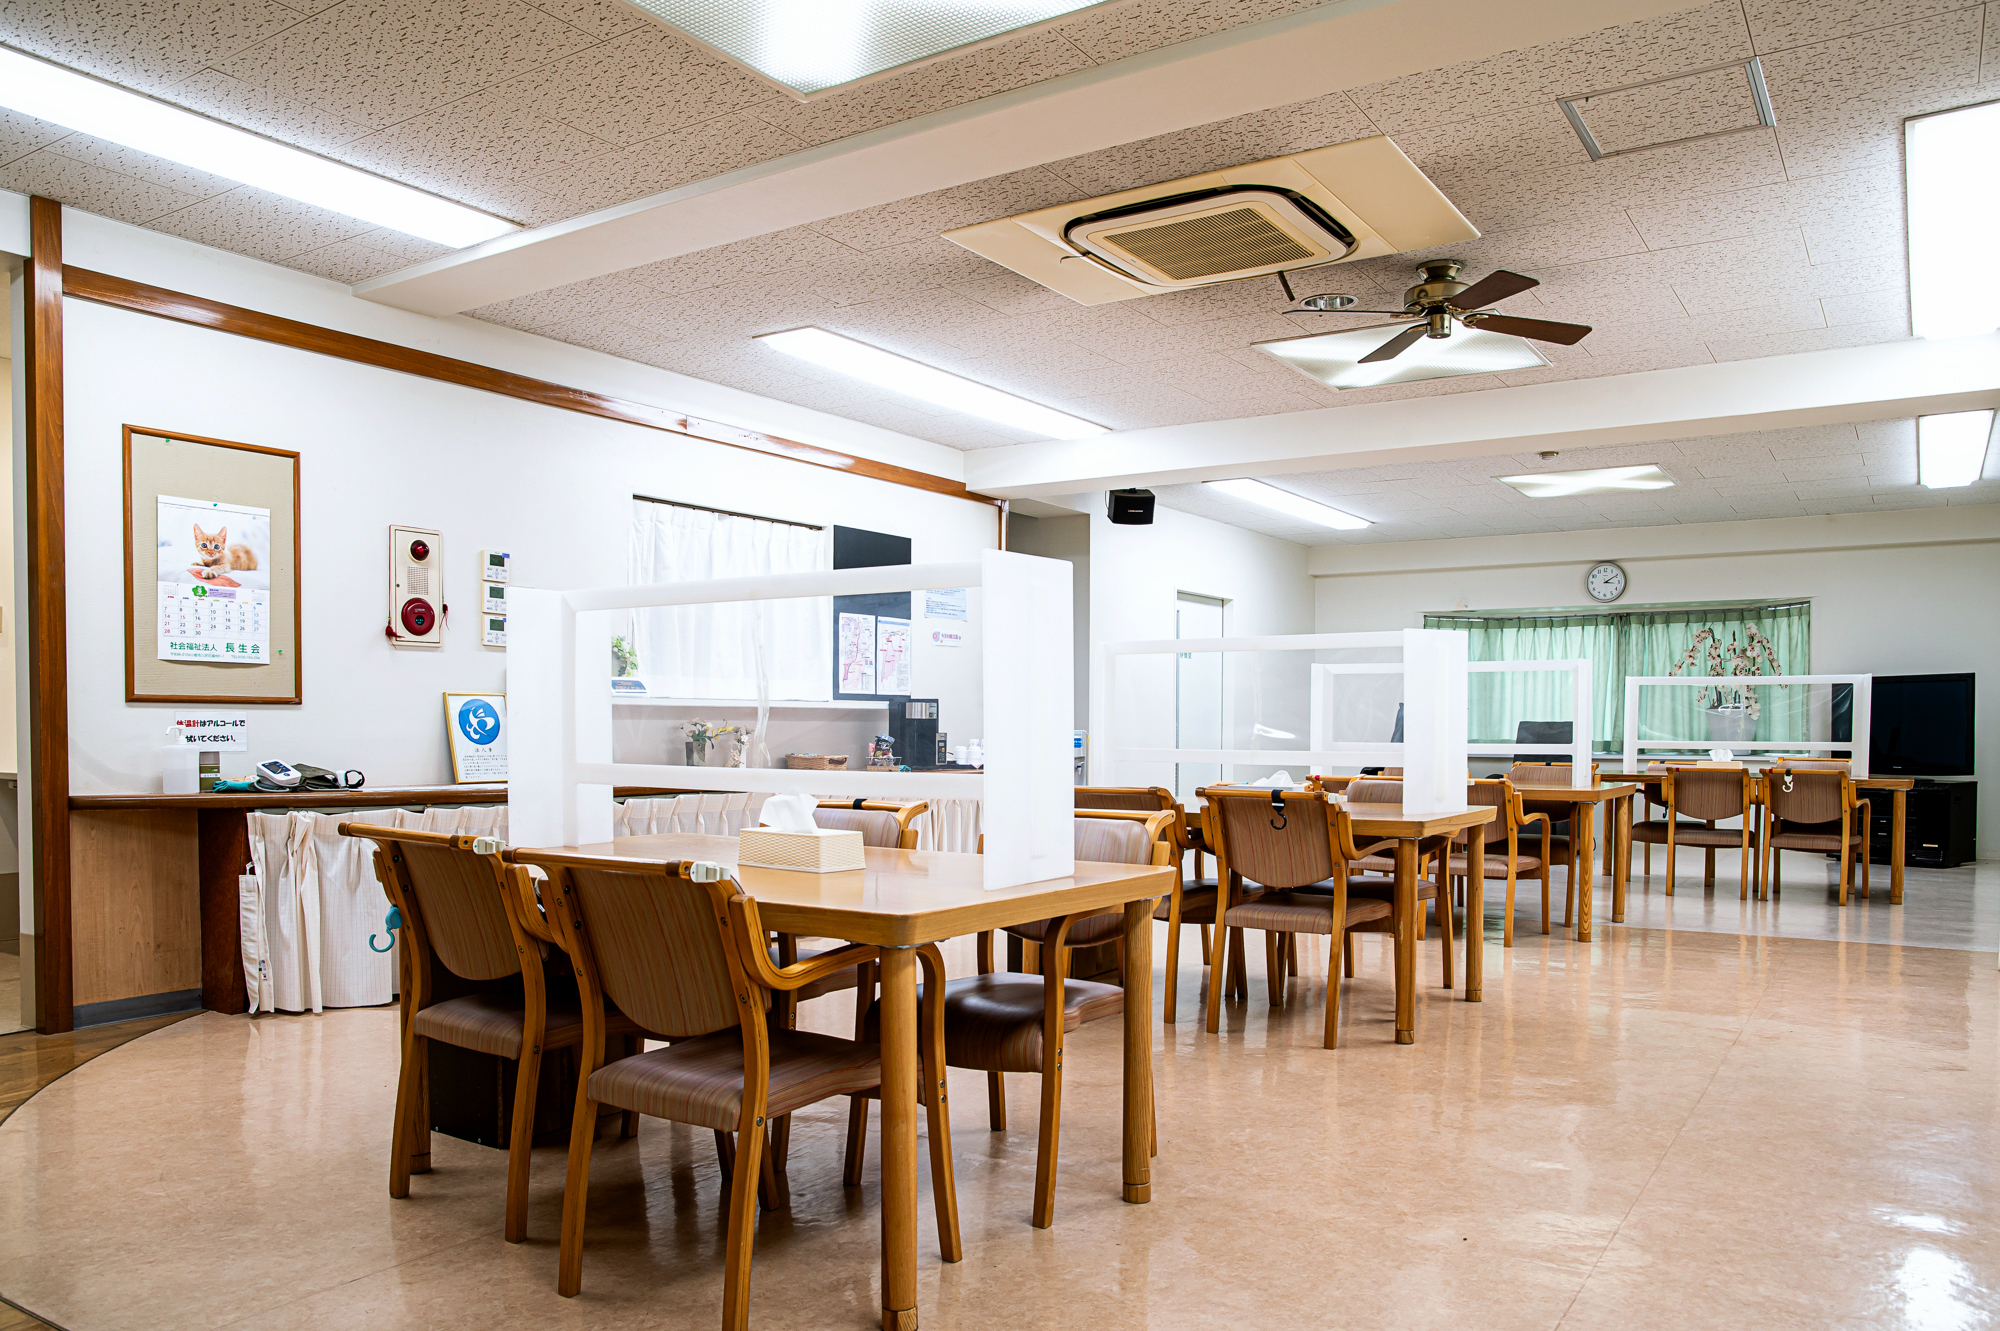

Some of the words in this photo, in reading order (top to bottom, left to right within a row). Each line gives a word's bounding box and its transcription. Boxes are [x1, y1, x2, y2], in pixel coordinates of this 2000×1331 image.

[170, 642, 217, 651] 社会福祉法人
[226, 643, 260, 653] 長生会
